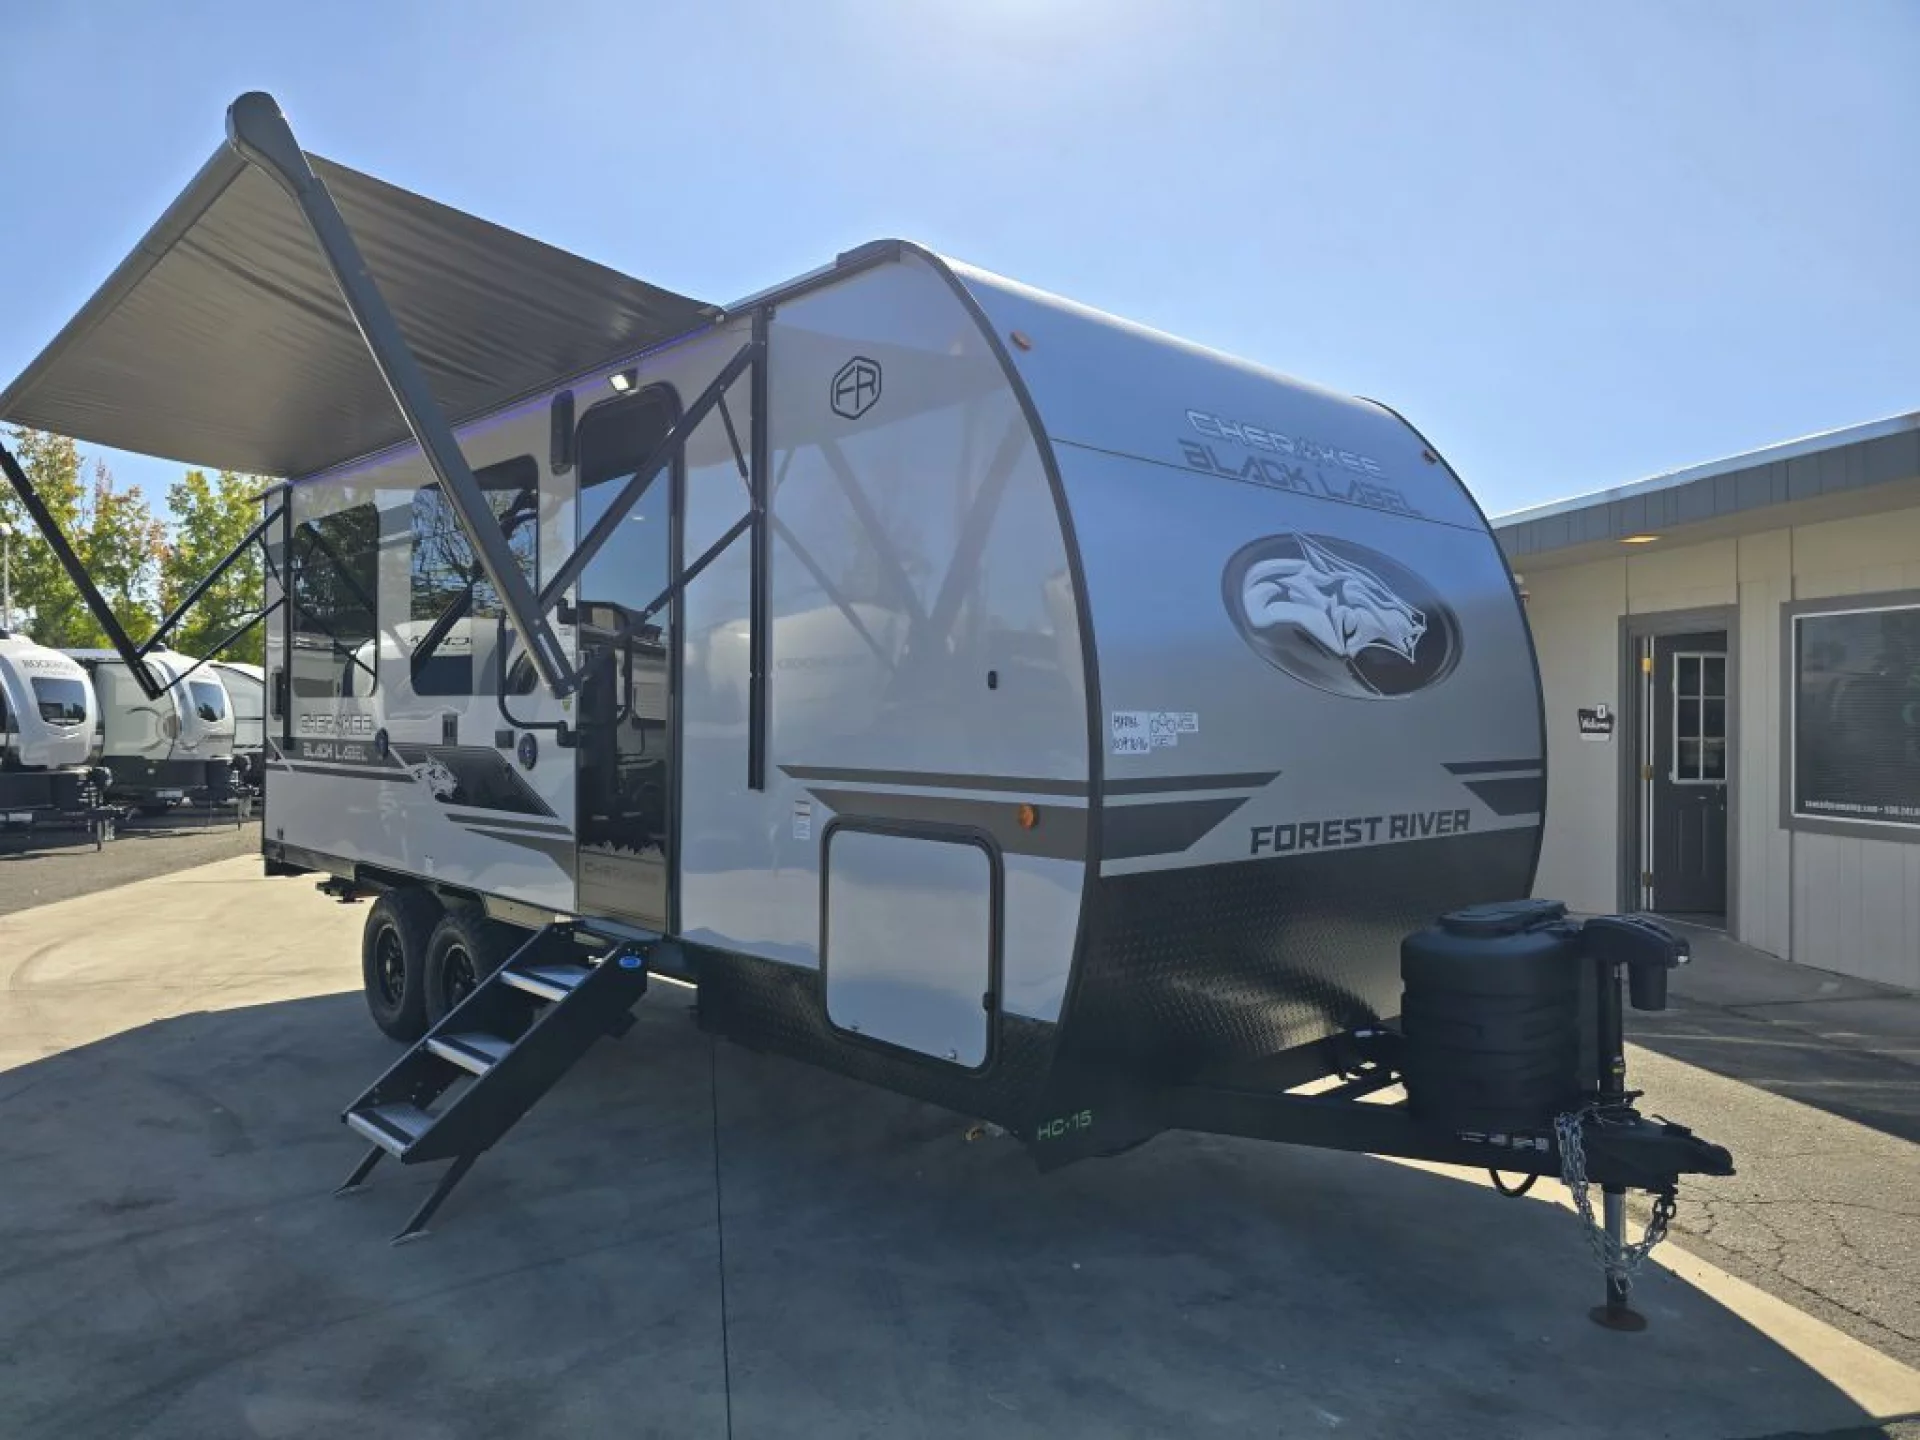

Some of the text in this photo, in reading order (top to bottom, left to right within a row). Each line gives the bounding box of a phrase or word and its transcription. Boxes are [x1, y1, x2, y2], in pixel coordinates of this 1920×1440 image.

[1177, 437, 1313, 493] BLACK
[1250, 808, 1471, 855] FOREST RIVER
